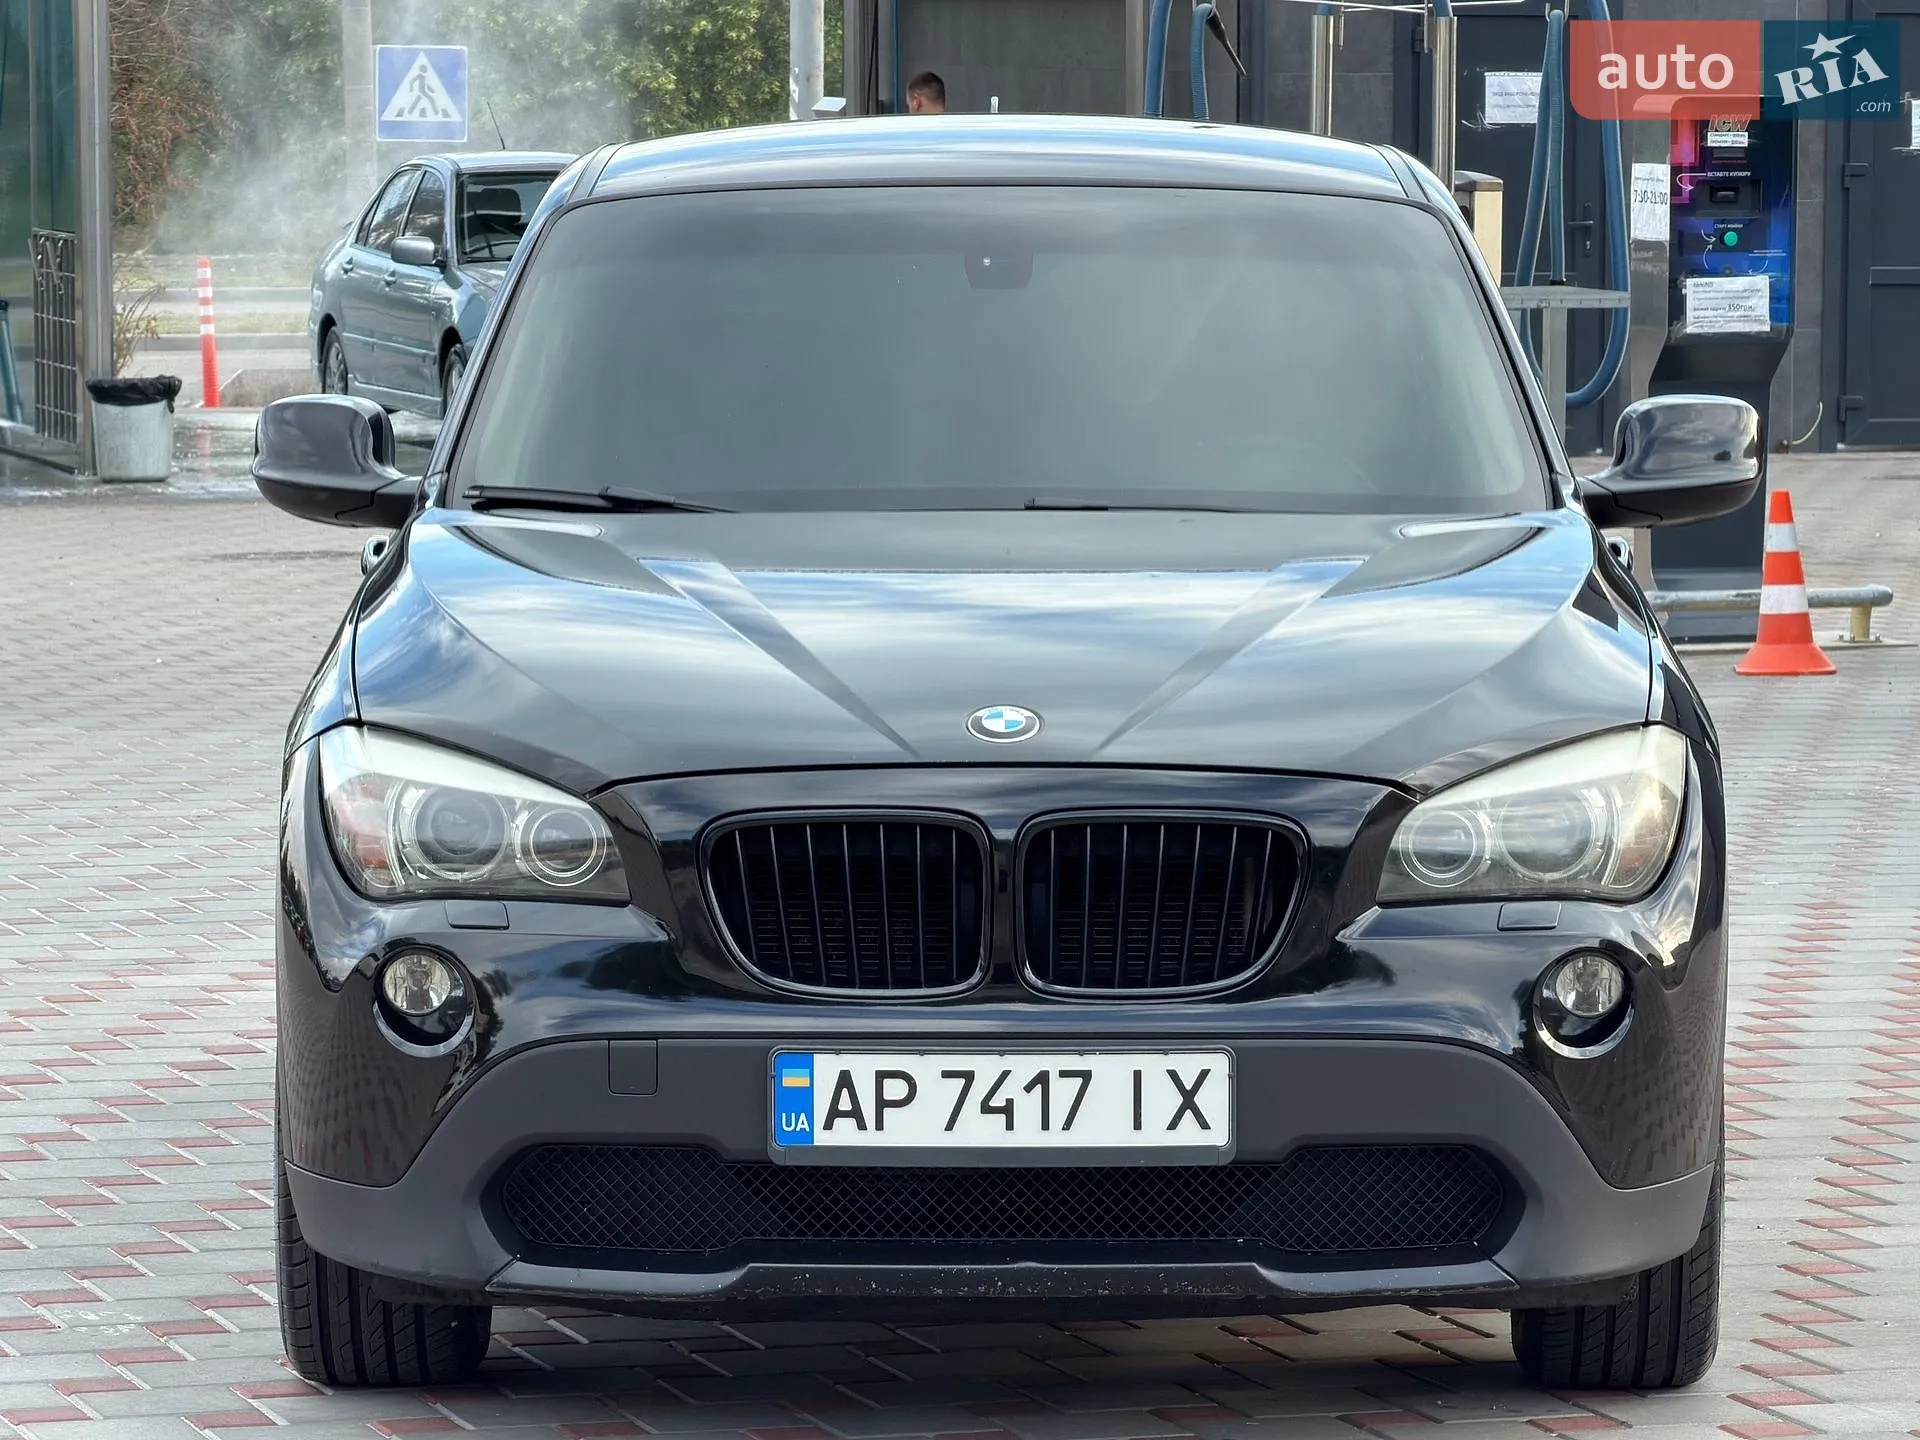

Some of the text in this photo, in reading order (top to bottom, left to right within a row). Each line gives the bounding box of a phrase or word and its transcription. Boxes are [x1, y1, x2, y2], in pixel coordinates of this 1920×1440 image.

[1708, 114, 1752, 132] ICW
[1633, 189, 1668, 205] 7:30-21:00
[822, 1068, 1212, 1131] AP 7417 IX
[781, 1112, 810, 1132] UA
